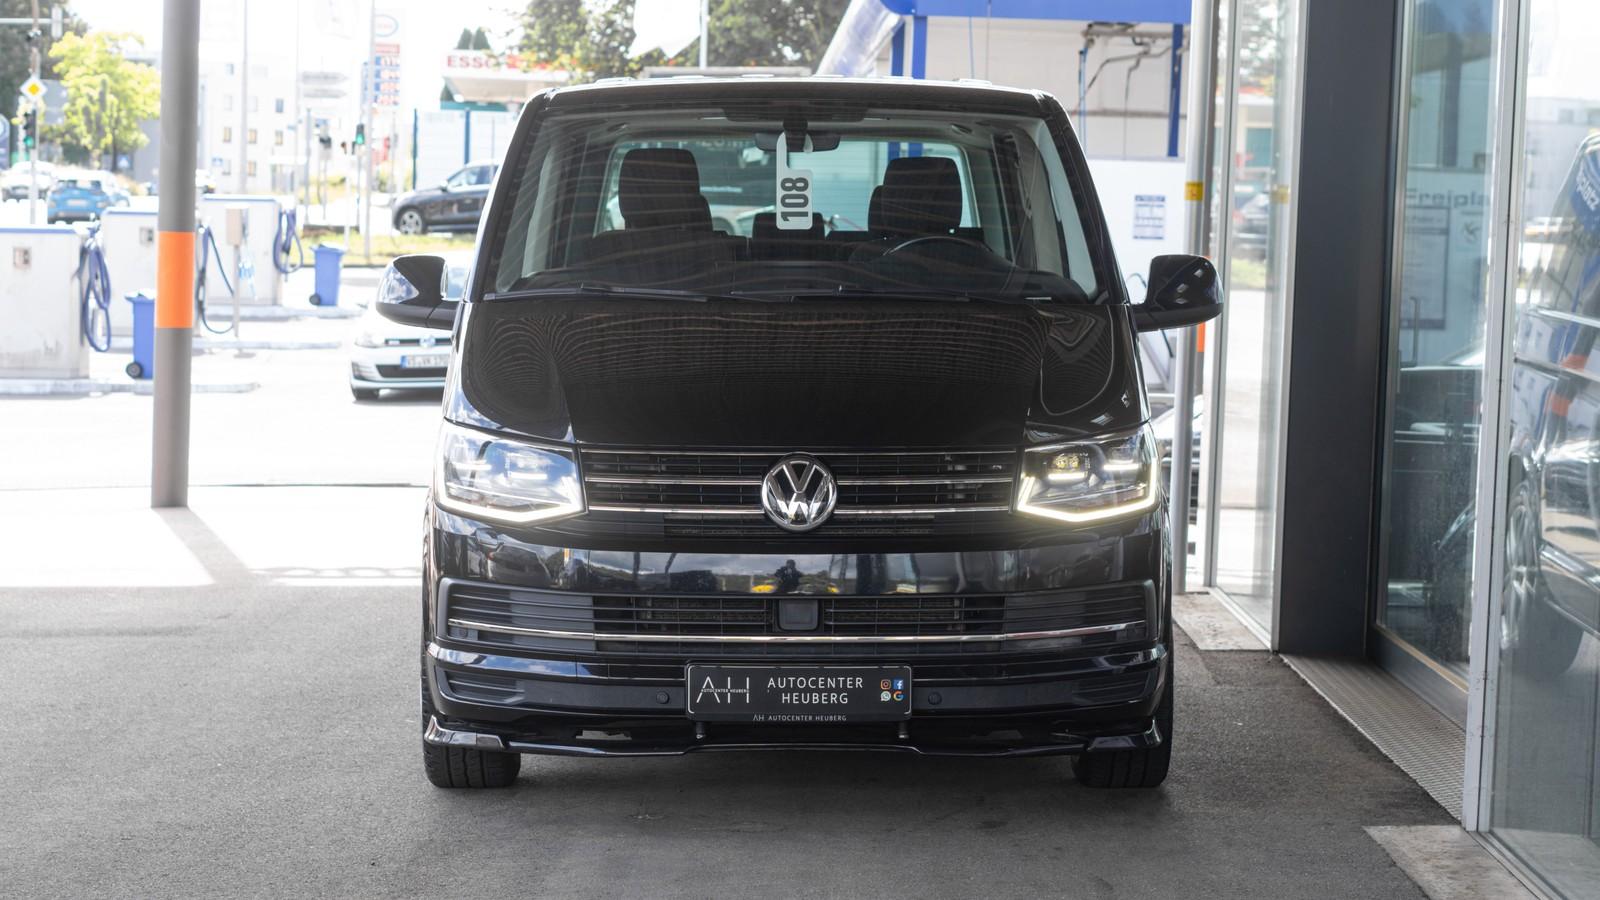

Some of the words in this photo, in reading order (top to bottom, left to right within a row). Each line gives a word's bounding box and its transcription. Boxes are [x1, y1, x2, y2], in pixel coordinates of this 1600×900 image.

[780, 177, 809, 222] 108
[696, 676, 750, 704] AH
[767, 677, 864, 689] AUTOCENTER
[781, 692, 849, 704] HEUBERG
